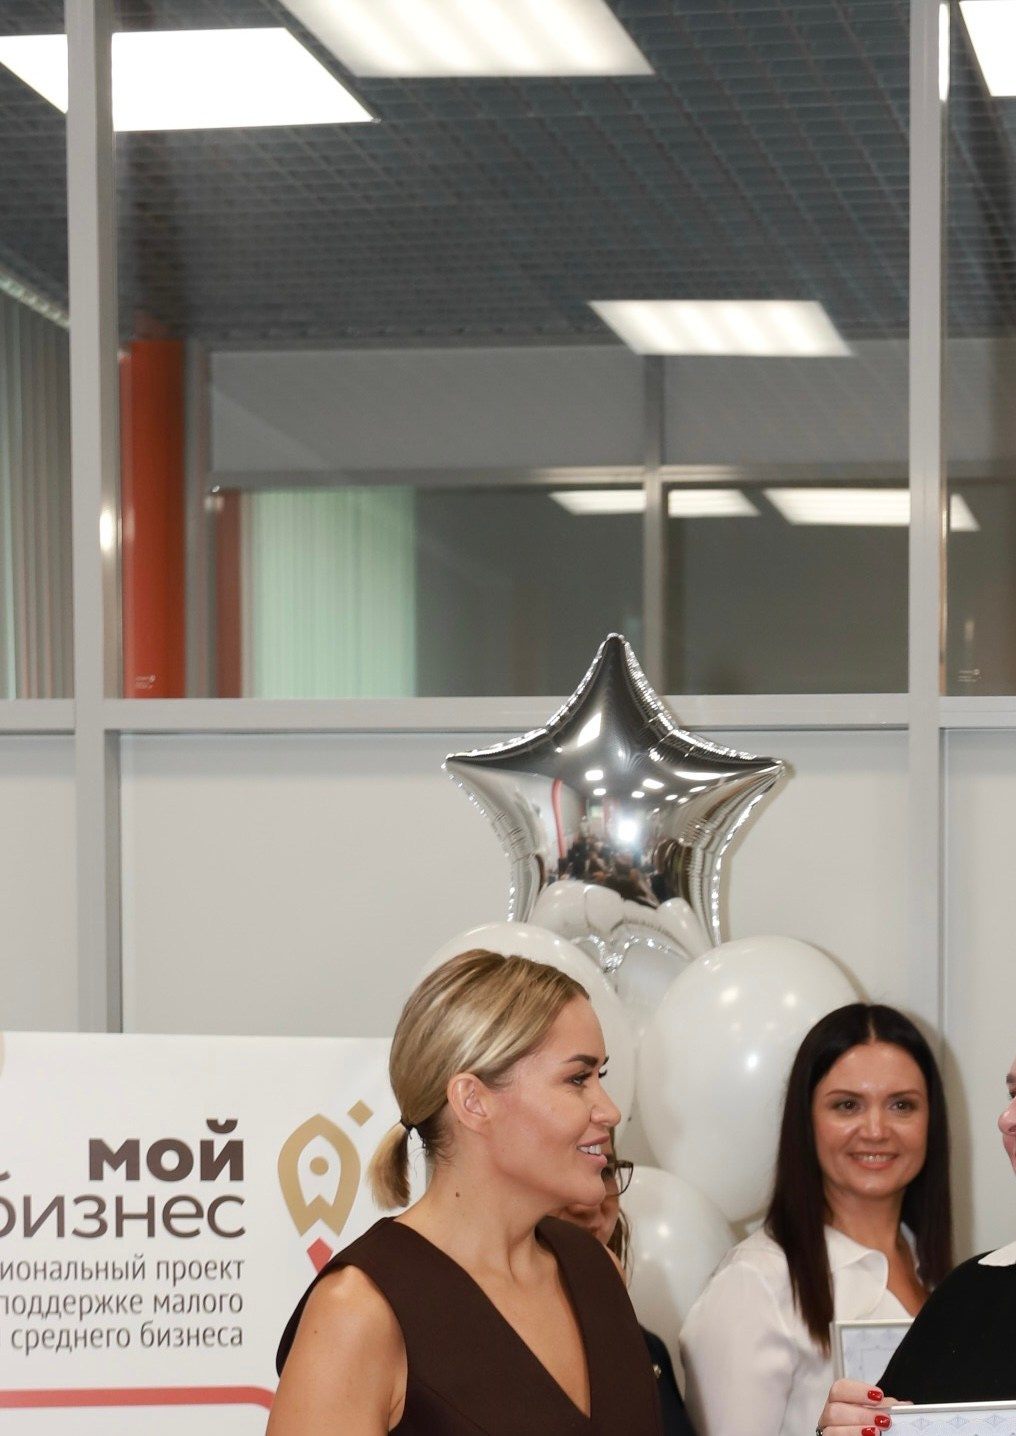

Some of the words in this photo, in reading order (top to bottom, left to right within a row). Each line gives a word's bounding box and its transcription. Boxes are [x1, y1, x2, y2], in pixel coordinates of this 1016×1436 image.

[89, 1118, 244, 1182] мой
[0, 1253, 146, 1281] иональный
[156, 1259, 245, 1287] проект
[154, 1292, 243, 1313] малого
[11, 1326, 131, 1356] среднего
[140, 1321, 243, 1348] бизнеса
